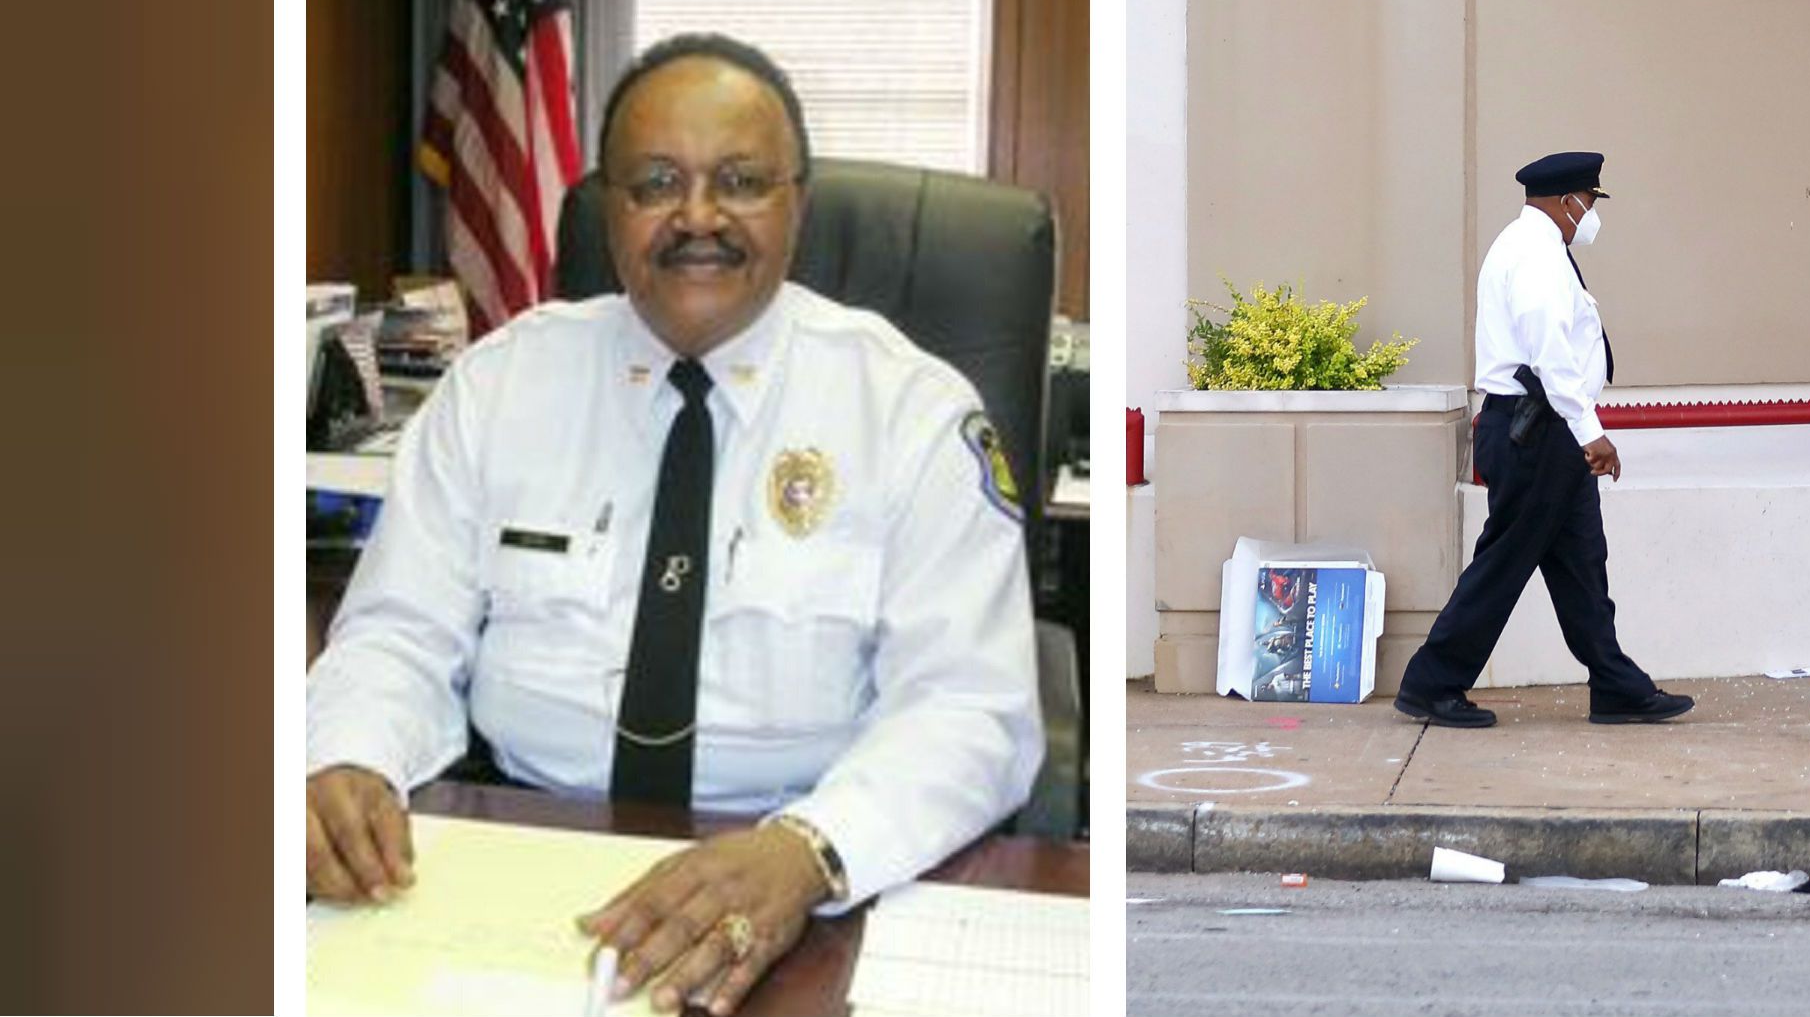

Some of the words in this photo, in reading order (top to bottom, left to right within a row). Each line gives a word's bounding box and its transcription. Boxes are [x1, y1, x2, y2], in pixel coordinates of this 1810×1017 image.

[1308, 582, 1317, 603] PLAY
[1306, 606, 1315, 620] TO
[1305, 621, 1315, 648] PLACE
[1303, 649, 1312, 670] BEST
[1303, 672, 1311, 689] THE
